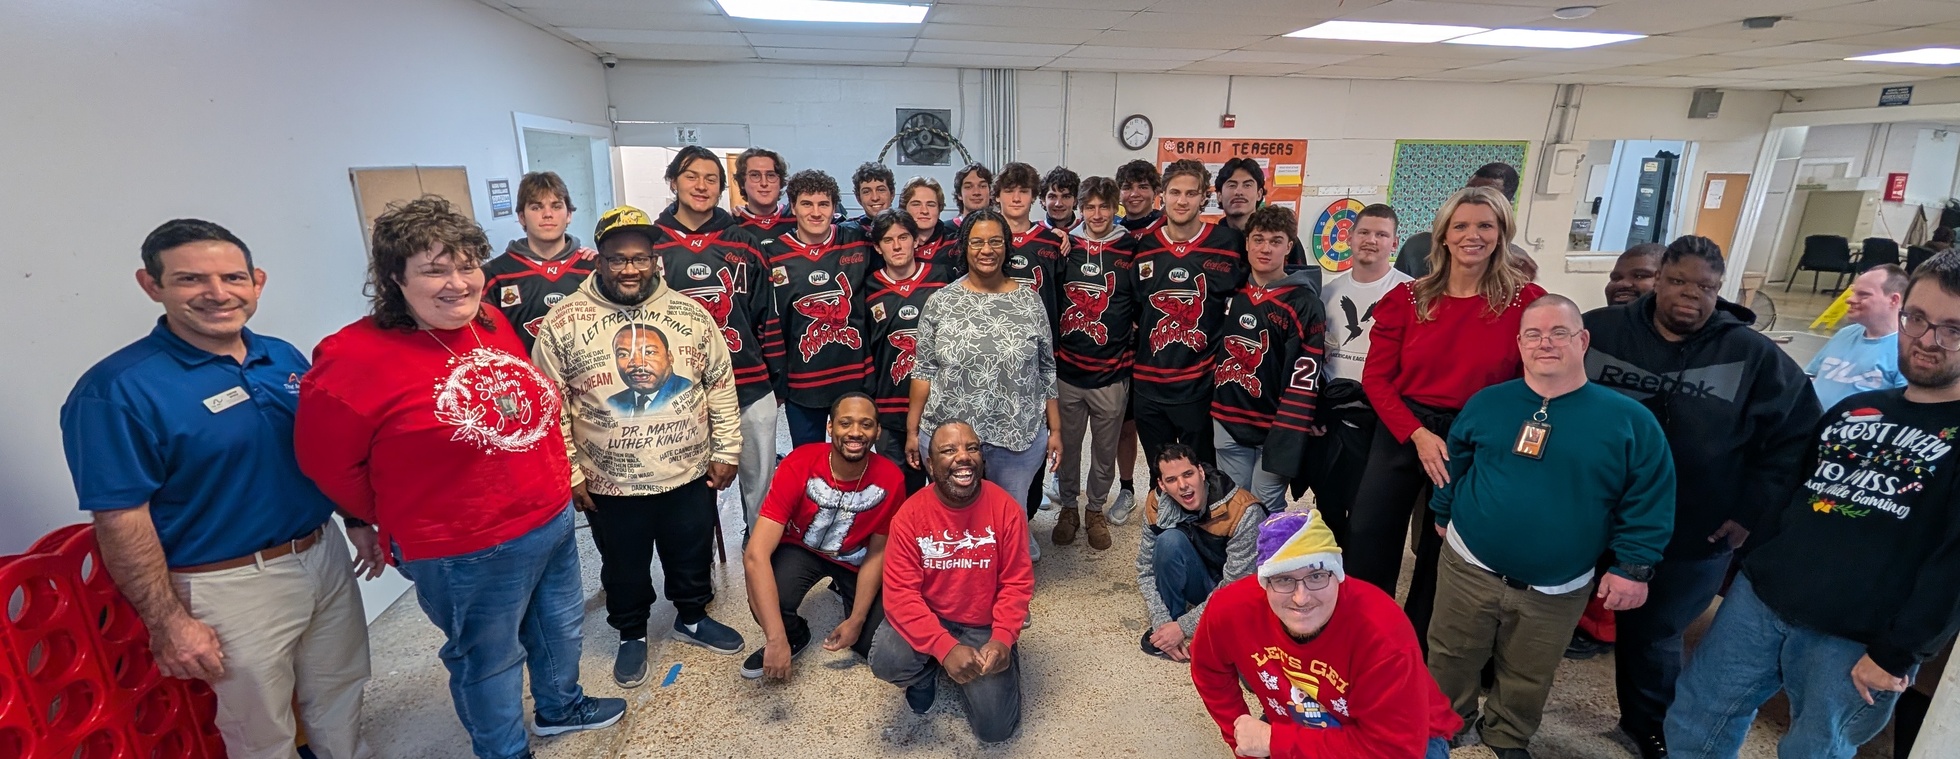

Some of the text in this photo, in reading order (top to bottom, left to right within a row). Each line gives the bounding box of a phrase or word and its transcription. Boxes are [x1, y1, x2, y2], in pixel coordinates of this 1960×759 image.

[1176, 141, 1293, 155] BRAIN TEASERS
[690, 267, 709, 276] NAHL
[734, 262, 747, 293] A
[811, 273, 828, 282] NAHL
[1171, 268, 1187, 279] NAHL
[555, 301, 574, 315] THANK
[567, 314, 576, 323] AT
[576, 313, 597, 322] LAST
[581, 321, 600, 346] LET
[600, 309, 661, 331] FREEDOM
[661, 315, 693, 338] RING
[583, 371, 614, 393] DREAM
[1290, 356, 1319, 391] 2
[621, 417, 690, 438] DR. MARTIN
[608, 437, 654, 450] LUTHER
[656, 431, 684, 448] KING
[1820, 422, 1952, 462] MOST LIKELY
[659, 449, 673, 462] HATE
[1814, 460, 1845, 482] TO
[1842, 469, 1900, 496] MISS
[631, 484, 664, 493] DARKNESS
[1850, 489, 1911, 520] Gaming
[923, 558, 991, 570] SLEIGHIN-IT
[1250, 646, 1302, 670] LET'S
